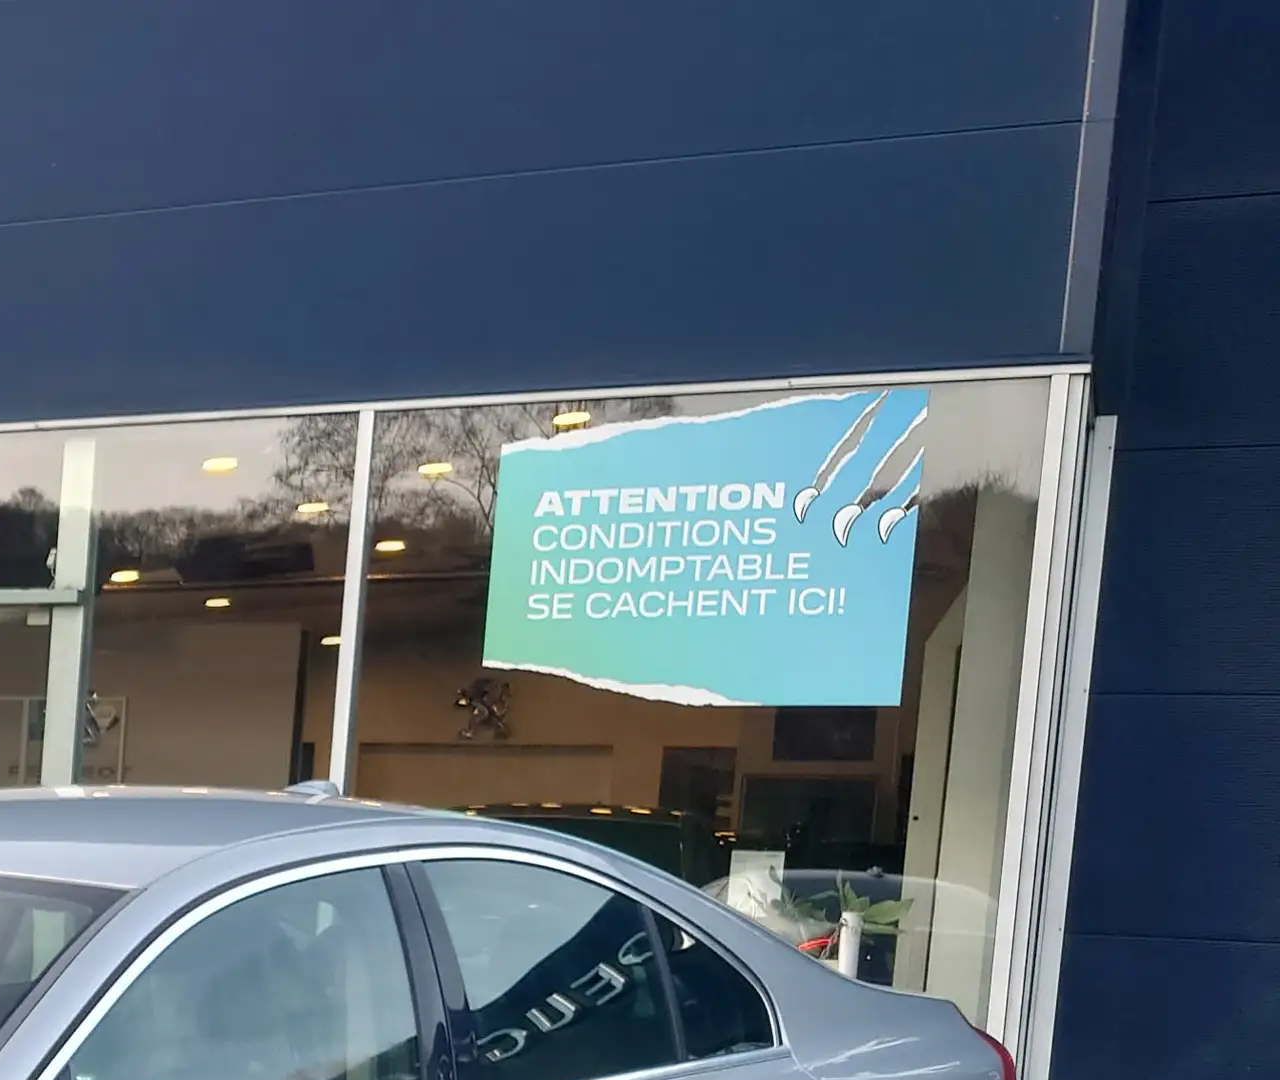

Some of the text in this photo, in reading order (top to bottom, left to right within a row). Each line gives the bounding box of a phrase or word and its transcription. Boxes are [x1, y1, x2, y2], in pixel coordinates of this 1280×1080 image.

[533, 482, 785, 517] ATTENTION
[532, 518, 777, 551] CONDITIONS
[530, 553, 811, 585] INDOMPTABLE
[526, 588, 846, 620] SE CACHENT ICI!
